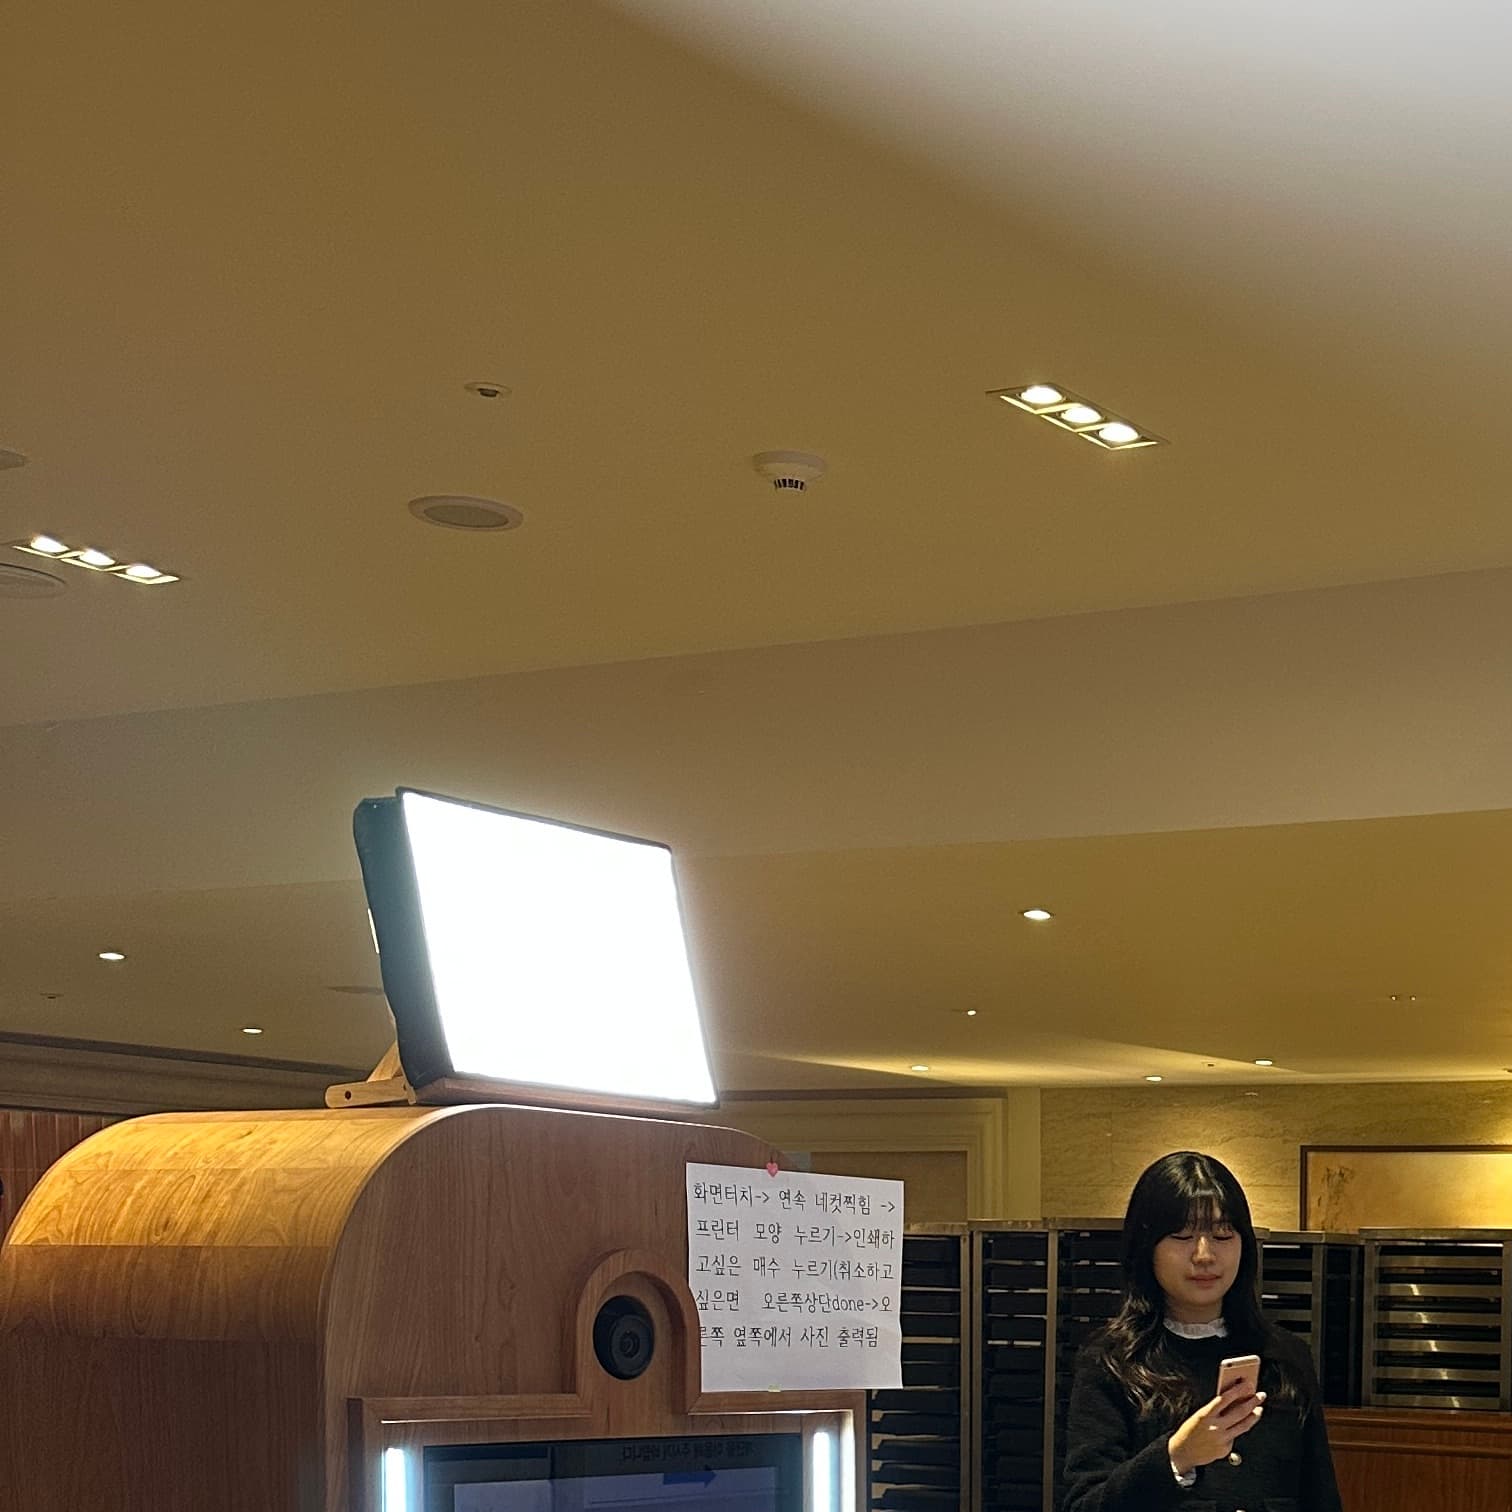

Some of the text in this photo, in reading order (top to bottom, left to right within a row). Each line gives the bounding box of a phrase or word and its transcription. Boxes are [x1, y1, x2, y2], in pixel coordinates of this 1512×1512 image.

[778, 1188, 807, 1211] 연속
[815, 1192, 870, 1216] 네컷찍힘
[695, 1218, 739, 1241] 프린터
[753, 1222, 782, 1245] 모양
[696, 1254, 742, 1277] 고싶은
[753, 1256, 781, 1279] 매수
[696, 1289, 740, 1312] 싶은면
[733, 1325, 791, 1348] 옆쪽에서
[800, 1326, 829, 1348] 사진
[837, 1326, 879, 1348] 출력됨
